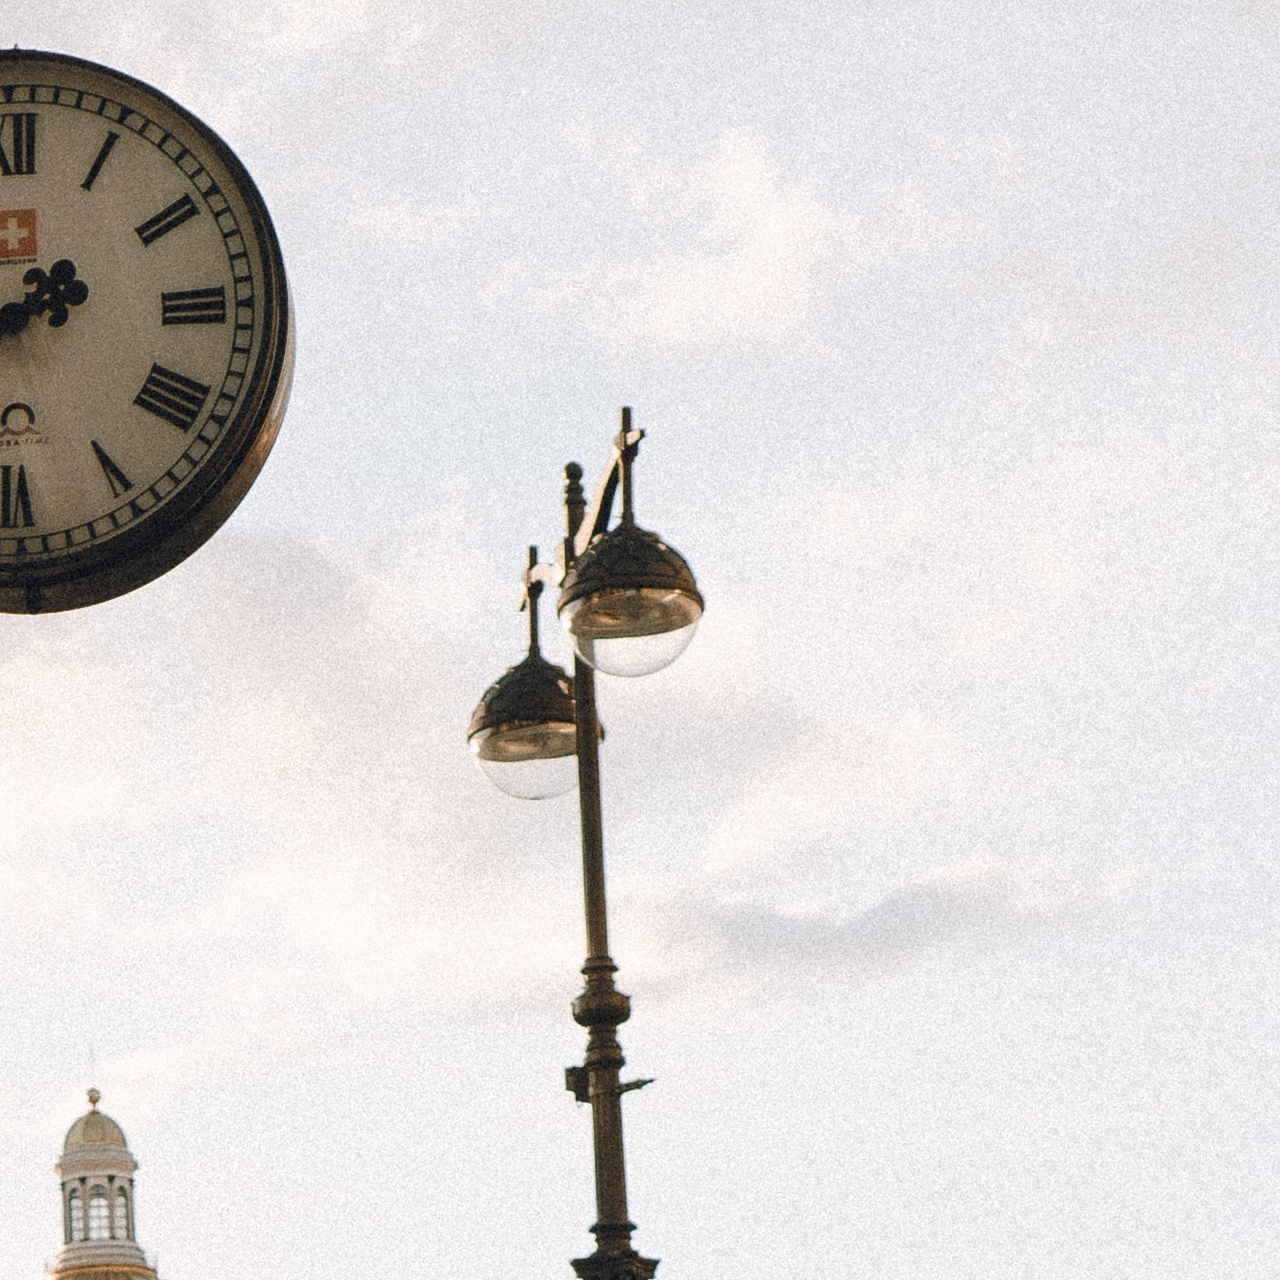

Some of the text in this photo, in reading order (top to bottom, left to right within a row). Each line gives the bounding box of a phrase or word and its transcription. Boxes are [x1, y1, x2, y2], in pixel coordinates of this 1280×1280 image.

[135, 192, 202, 247] II
[161, 285, 226, 326] III
[0, 464, 35, 529] VI
[91, 440, 135, 498] V
